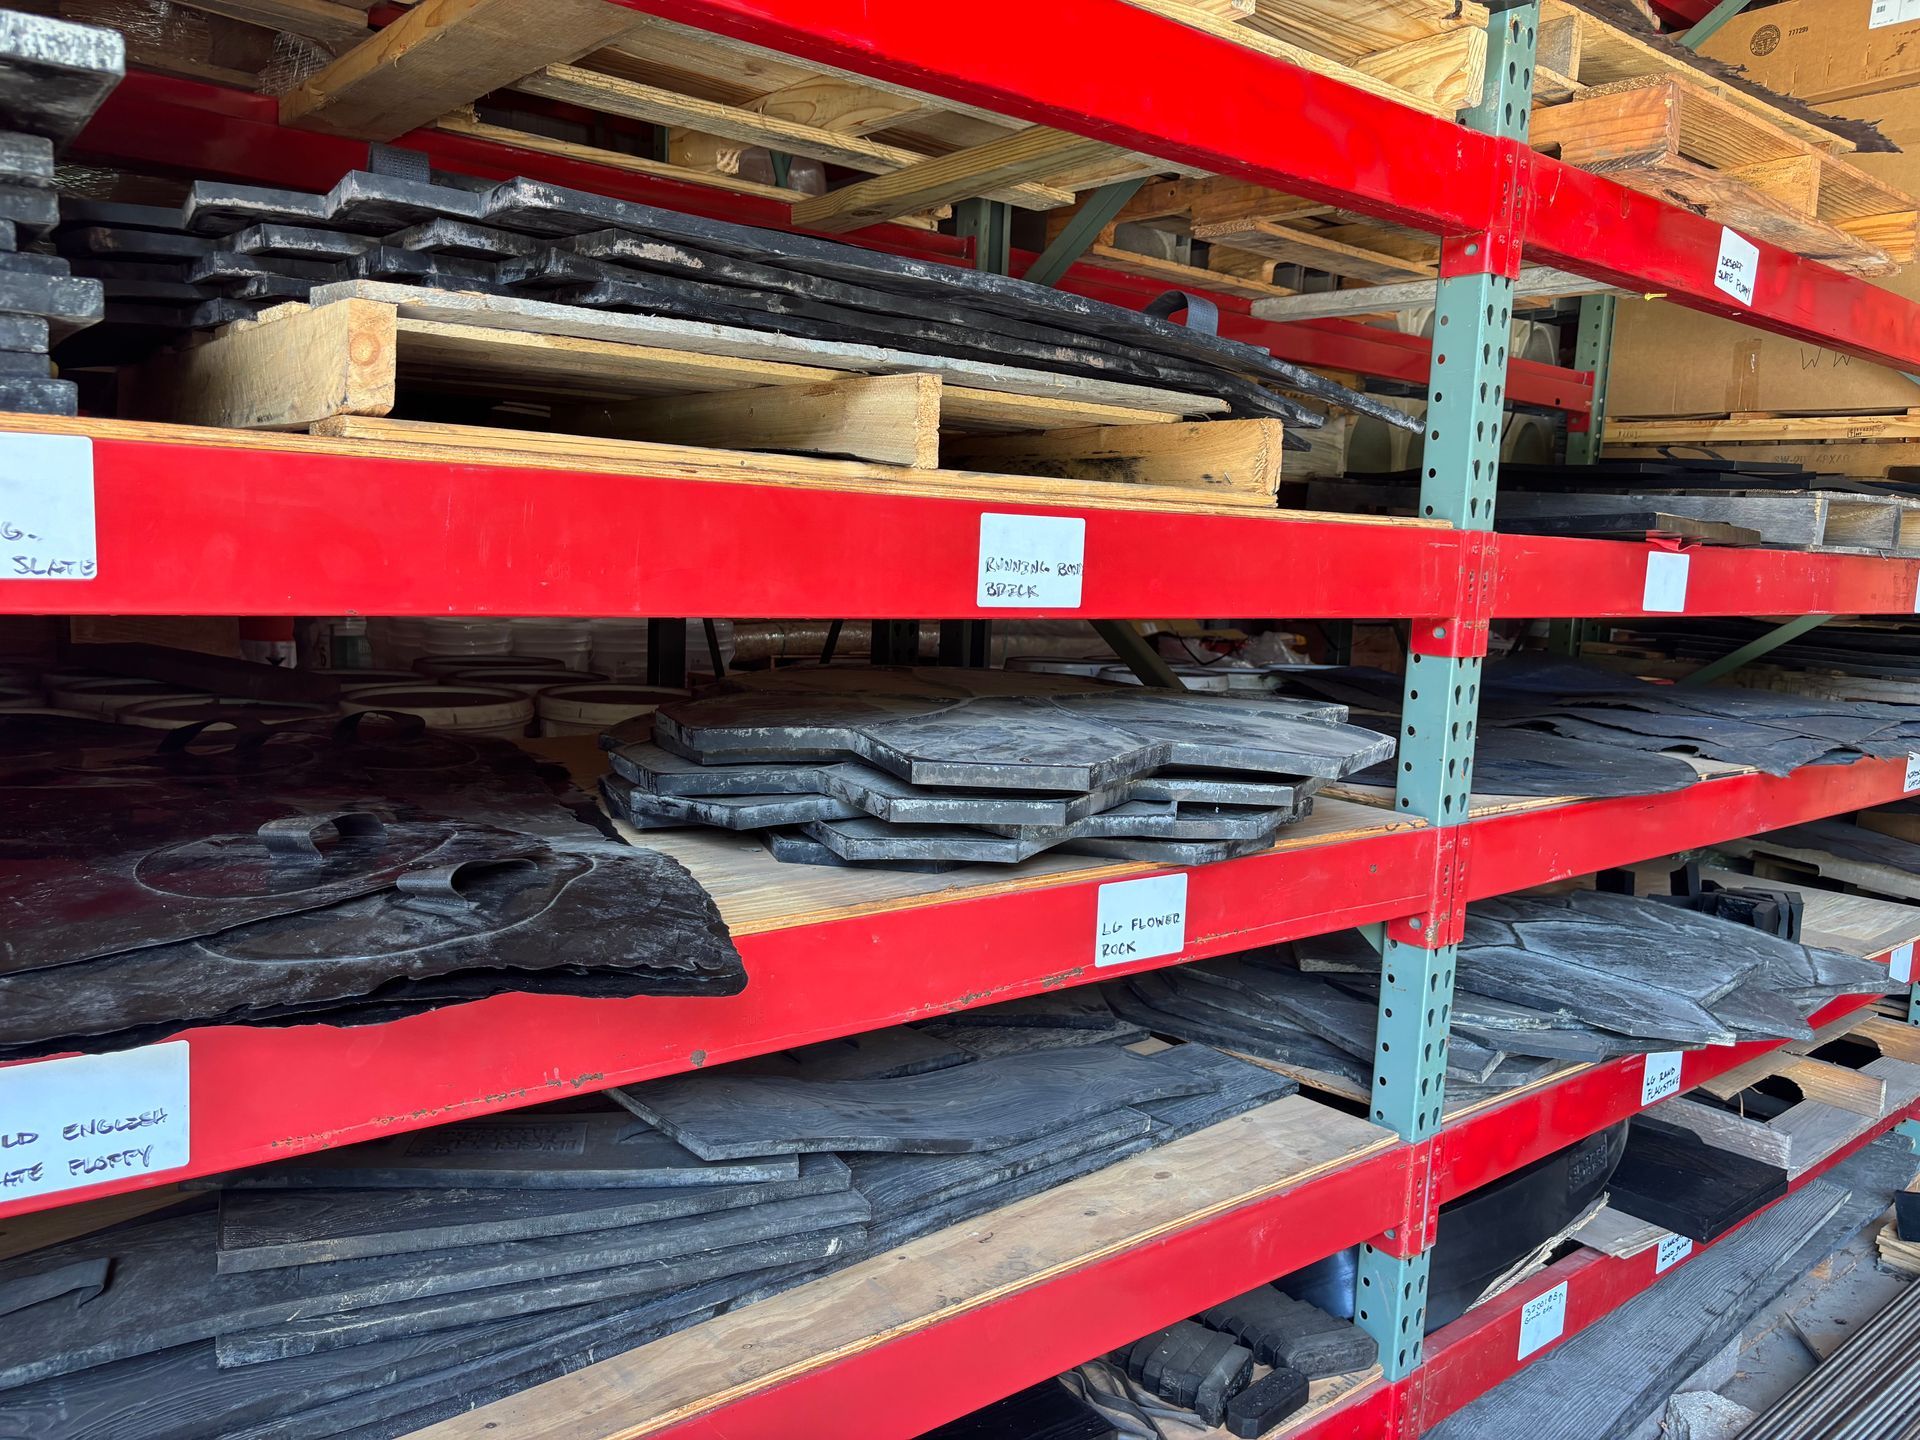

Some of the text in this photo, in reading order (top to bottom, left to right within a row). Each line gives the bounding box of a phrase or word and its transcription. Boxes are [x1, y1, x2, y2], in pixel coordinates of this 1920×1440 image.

[12, 555, 95, 576] SLATE
[1101, 912, 1180, 936] LG FLOWER
[1101, 940, 1137, 958] ROCK
[1646, 1075, 1657, 1086] LG
[62, 1107, 168, 1141] ENGLISH
